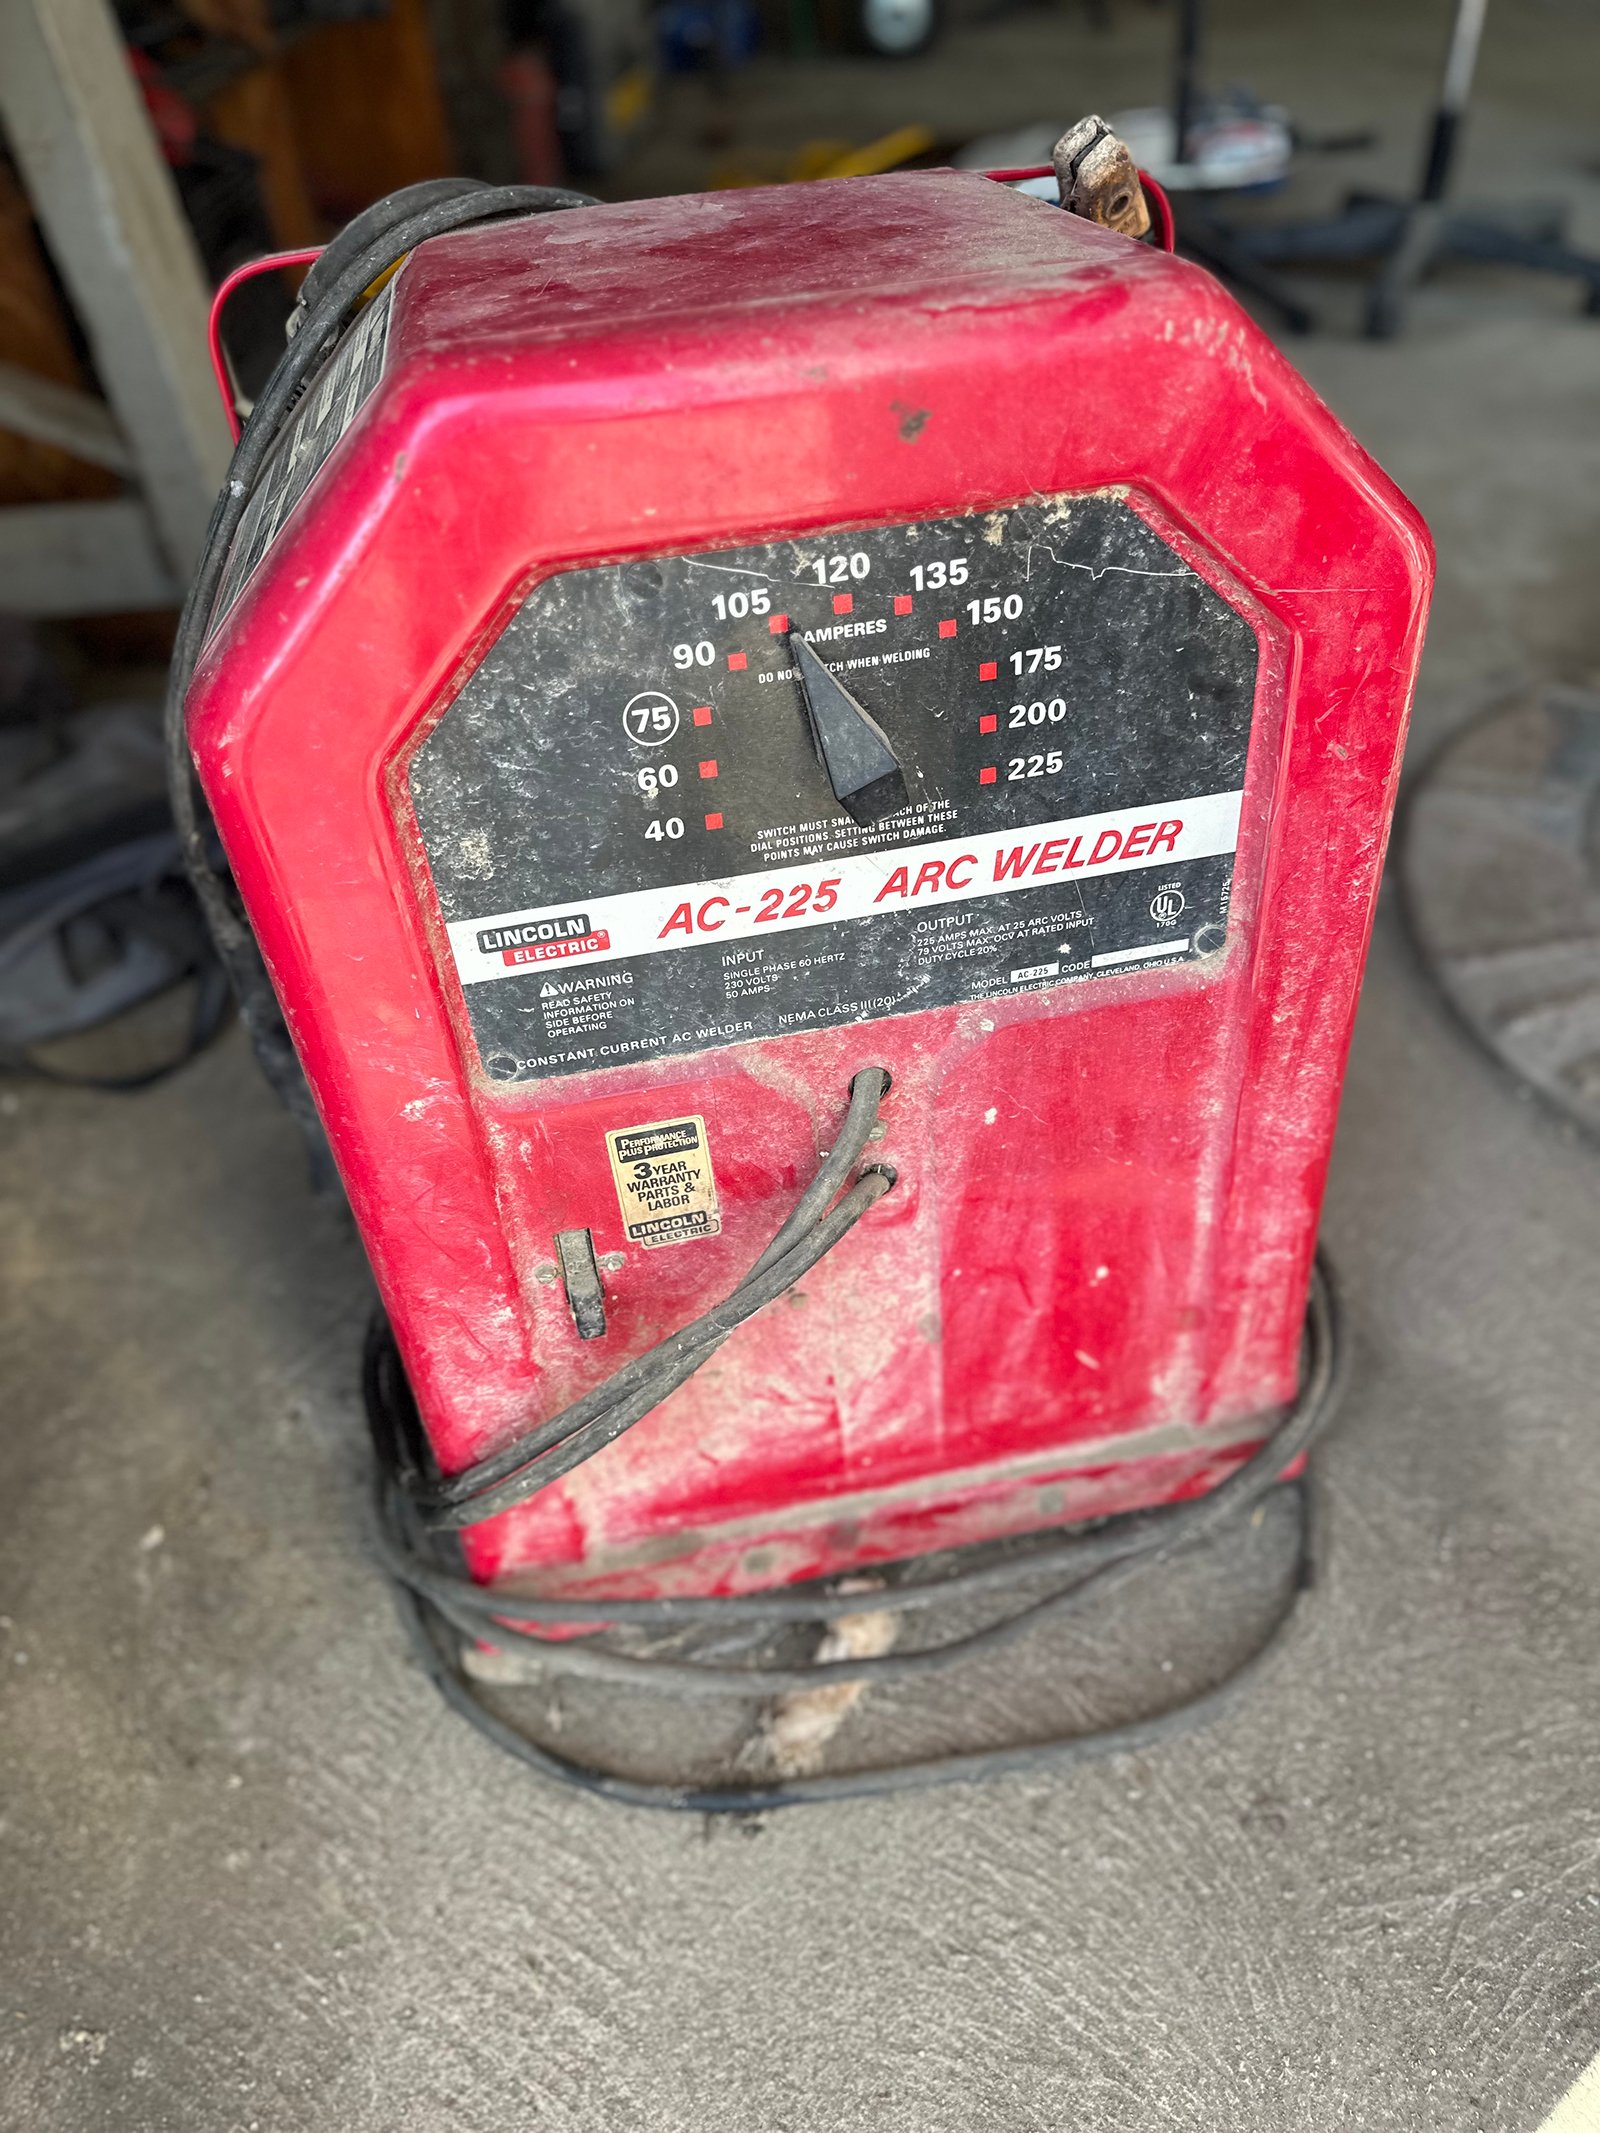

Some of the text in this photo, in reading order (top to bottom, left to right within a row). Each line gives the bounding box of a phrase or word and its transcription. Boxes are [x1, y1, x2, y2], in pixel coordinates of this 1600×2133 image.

[812, 553, 870, 585] 120
[909, 558, 969, 591] 135
[711, 589, 771, 621] 105
[966, 594, 1024, 626] 150
[804, 619, 888, 644] AMPERES
[673, 641, 716, 670] 90
[758, 672, 774, 684] DO
[847, 655, 879, 670] WHEN
[882, 648, 931, 664] WELDING
[1009, 646, 1063, 676] 175
[631, 706, 671, 733] 75
[1008, 699, 1067, 728] 200
[638, 765, 679, 792] 60
[1007, 751, 1064, 781] 225
[644, 818, 685, 842] 40
[750, 841, 773, 853] DIAL
[835, 824, 876, 839] SETTING
[878, 816, 924, 831] BETWEEN
[928, 810, 958, 823] THESE
[757, 825, 796, 840] SWITCH
[799, 820, 828, 833] MUST
[916, 802, 929, 813] OF
[932, 800, 950, 811] THE
[764, 824, 947, 862] POINTS MAY CAUSE SWITCH DAMAGE.
[657, 819, 1184, 939] AC-225 ARC WELDER
[1158, 882, 1181, 891] LISTED
[482, 918, 586, 950] LINCOLN
[917, 913, 974, 933] OUTPUT
[917, 937, 935, 947] 225
[938, 931, 967, 943] AMPS
[998, 923, 1011, 933] AT
[1013, 921, 1025, 930] 25
[1028, 916, 1049, 927] ARC
[1050, 910, 1082, 923] VOLTS
[918, 947, 930, 956] 79
[931, 941, 964, 955] VOLTS
[994, 932, 1014, 942] OCV
[1016, 928, 1030, 938] AT
[1032, 924, 1063, 936] RATED
[1065, 917, 1095, 930] INPUT
[722, 950, 765, 967] INPUT
[723, 953, 846, 981] SINGLE PHASE 60 HERTZ
[918, 945, 997, 966] DUTY CYCLE 20%
[557, 972, 634, 994] WARNING
[725, 974, 779, 990] 230 VOLTS
[970, 992, 985, 1001] THE
[985, 986, 1018, 999] LINCOLN
[1019, 978, 1054, 993] ELECTRIC
[1143, 960, 1163, 969] OHIO
[971, 960, 1091, 990] MODEL AC-225 CODE
[541, 992, 612, 1010] READ SAFETY
[726, 985, 771, 999] 50 AMPS
[543, 998, 635, 1019] INFORMATION ON
[545, 1011, 613, 1029] SIDE BEFORE
[516, 1048, 595, 1070] CONSTANT
[599, 1036, 668, 1056] CURRENT
[672, 1029, 693, 1043] AC
[696, 1020, 753, 1039] WELDER
[778, 1010, 816, 1025] NEMA
[818, 1002, 858, 1017] CLASS
[547, 1022, 607, 1038] OPERATING
[627, 1169, 701, 1193] WARRANTY
[633, 1161, 687, 1180] 3 YEAR
[638, 1182, 695, 1202] PARTS &
[648, 1194, 690, 1211] LABOR
[631, 1213, 705, 1238] LINCOLN
[651, 1225, 711, 1243] ELECTRIC
